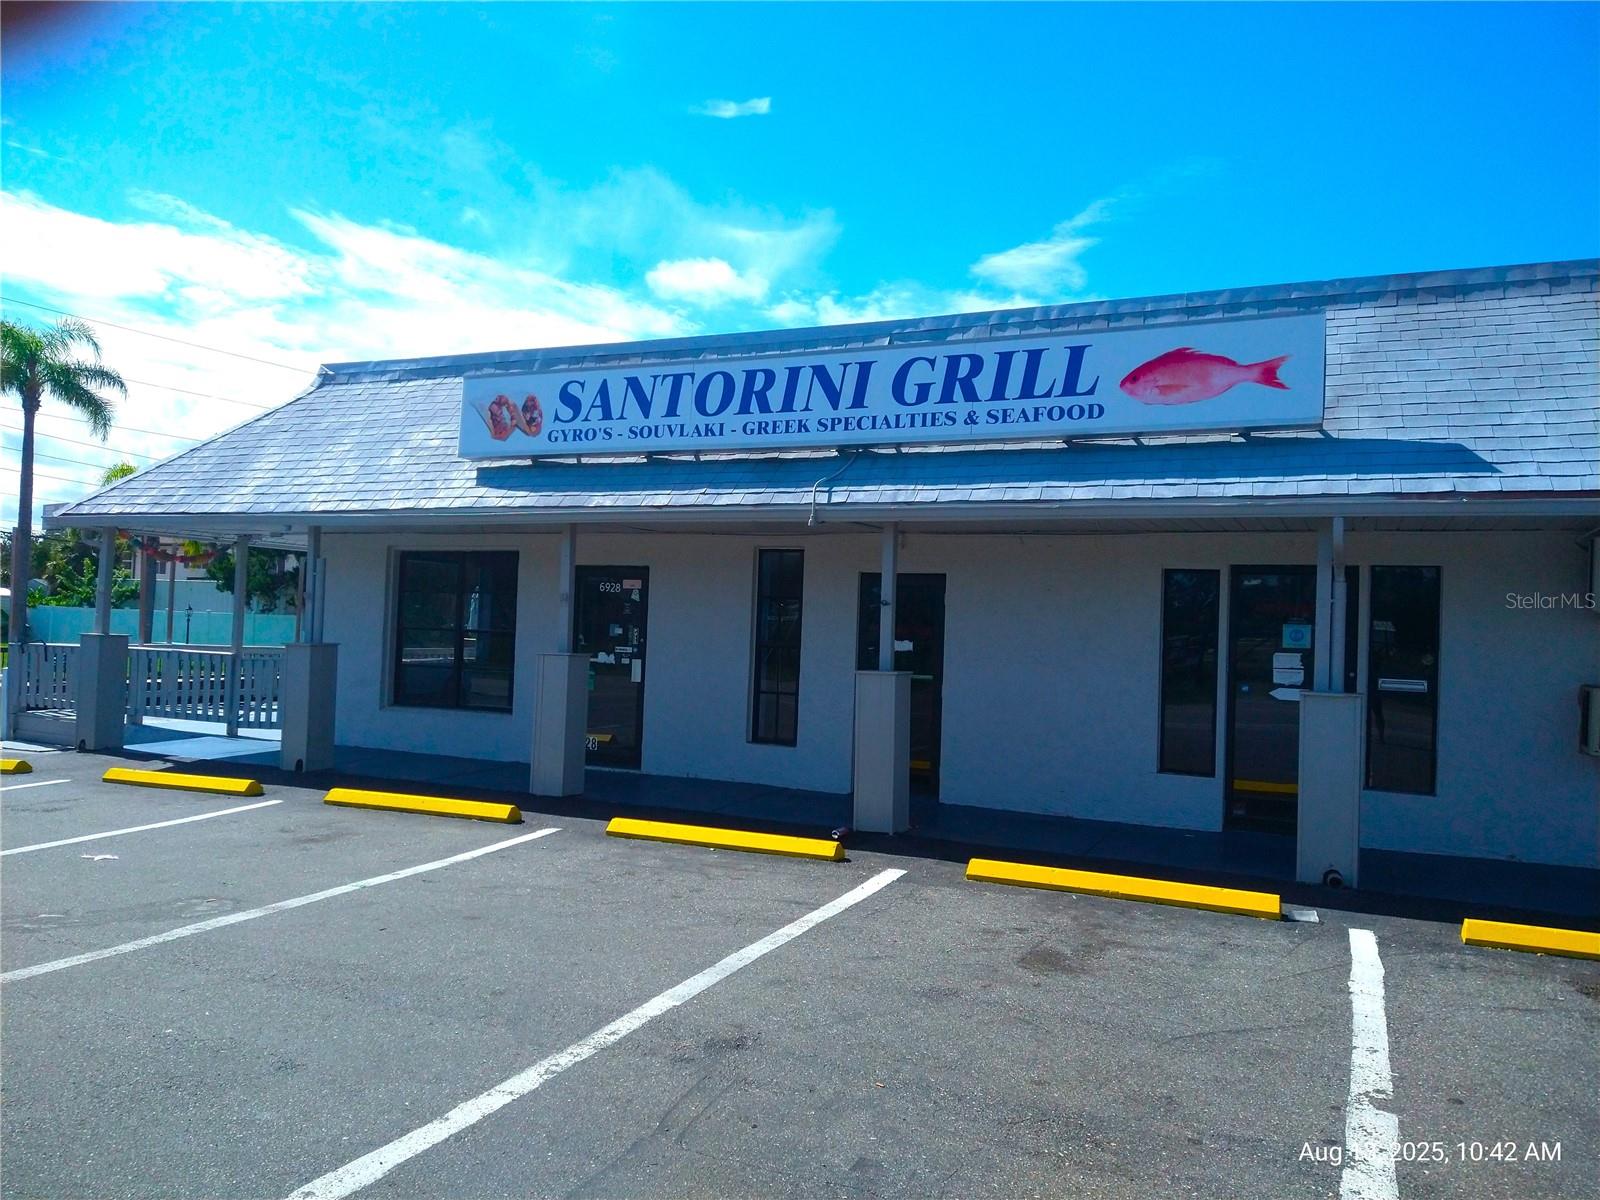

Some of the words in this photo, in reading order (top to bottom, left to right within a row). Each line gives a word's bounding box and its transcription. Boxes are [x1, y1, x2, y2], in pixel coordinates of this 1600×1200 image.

[553, 360, 877, 424] SANTORINI
[892, 344, 1100, 407] GRILL
[547, 427, 613, 443] GYRO'S
[627, 422, 726, 440] SOUVLAKI
[742, 418, 811, 436] GREEK
[816, 410, 957, 433] SPECIALTIES
[963, 409, 980, 426] &
[985, 403, 1105, 426] SEAFOOD
[600, 582, 621, 593] 6928
